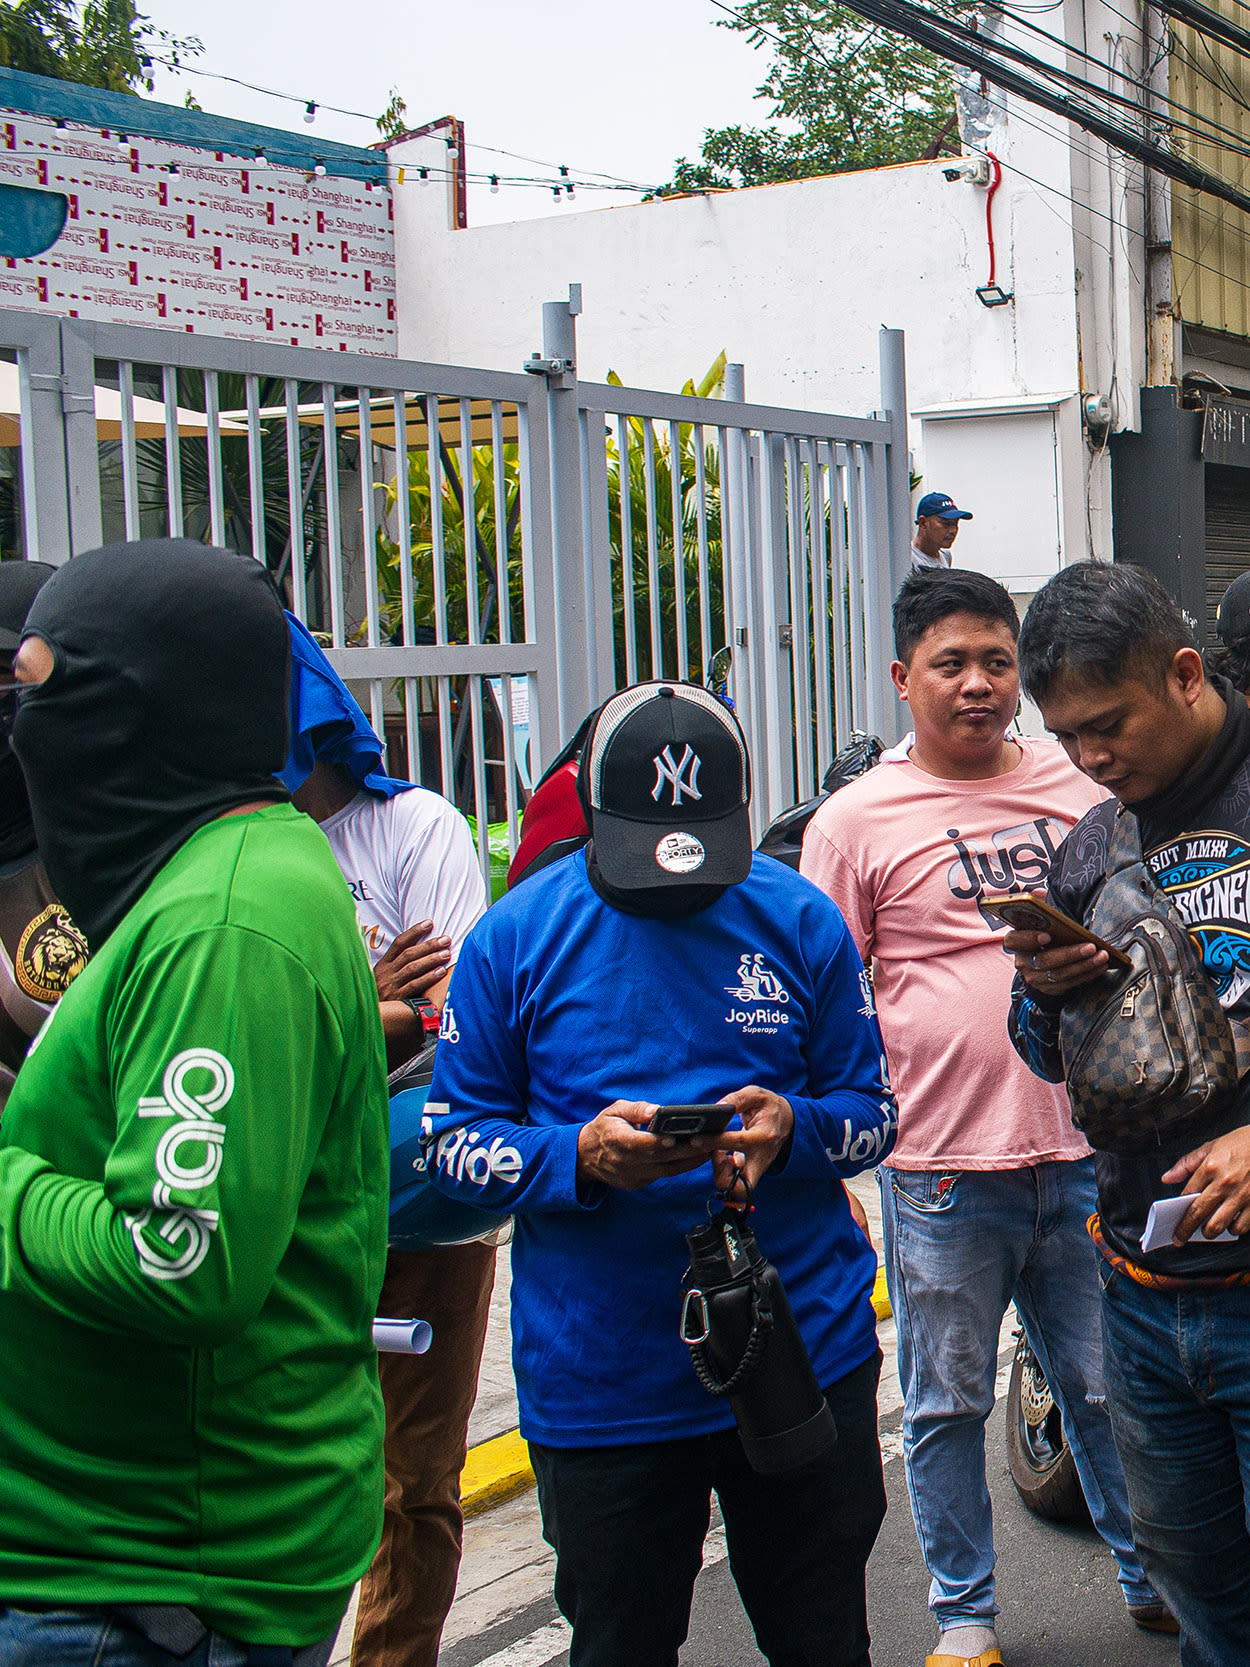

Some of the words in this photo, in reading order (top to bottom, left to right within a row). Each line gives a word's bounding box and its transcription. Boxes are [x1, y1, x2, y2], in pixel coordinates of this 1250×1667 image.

[182, 166, 228, 187] Shanghai
[94, 178, 144, 199] Shanghai
[312, 187, 352, 204] Shanghai
[209, 199, 254, 219] Shanghai
[124, 212, 173, 232] Shanghai
[336, 217, 376, 234] Shanghai
[235, 231, 279, 250] Shanghai
[153, 244, 200, 264] Shanghai
[360, 246, 396, 263] Shangha
[63, 259, 115, 279] Shanghai
[261, 262, 304, 280] Shanghai
[181, 276, 227, 295] Shanghai
[93, 292, 144, 311] Shanghai
[287, 292, 312, 307] nghai
[312, 290, 352, 307] Shanghai
[208, 308, 253, 325] Shanghai
[335, 320, 376, 336] Shanghai
[724, 1008, 789, 1026] JoyRide
[742, 1026, 778, 1034] Superapp
[125, 1047, 235, 1280] Grab
